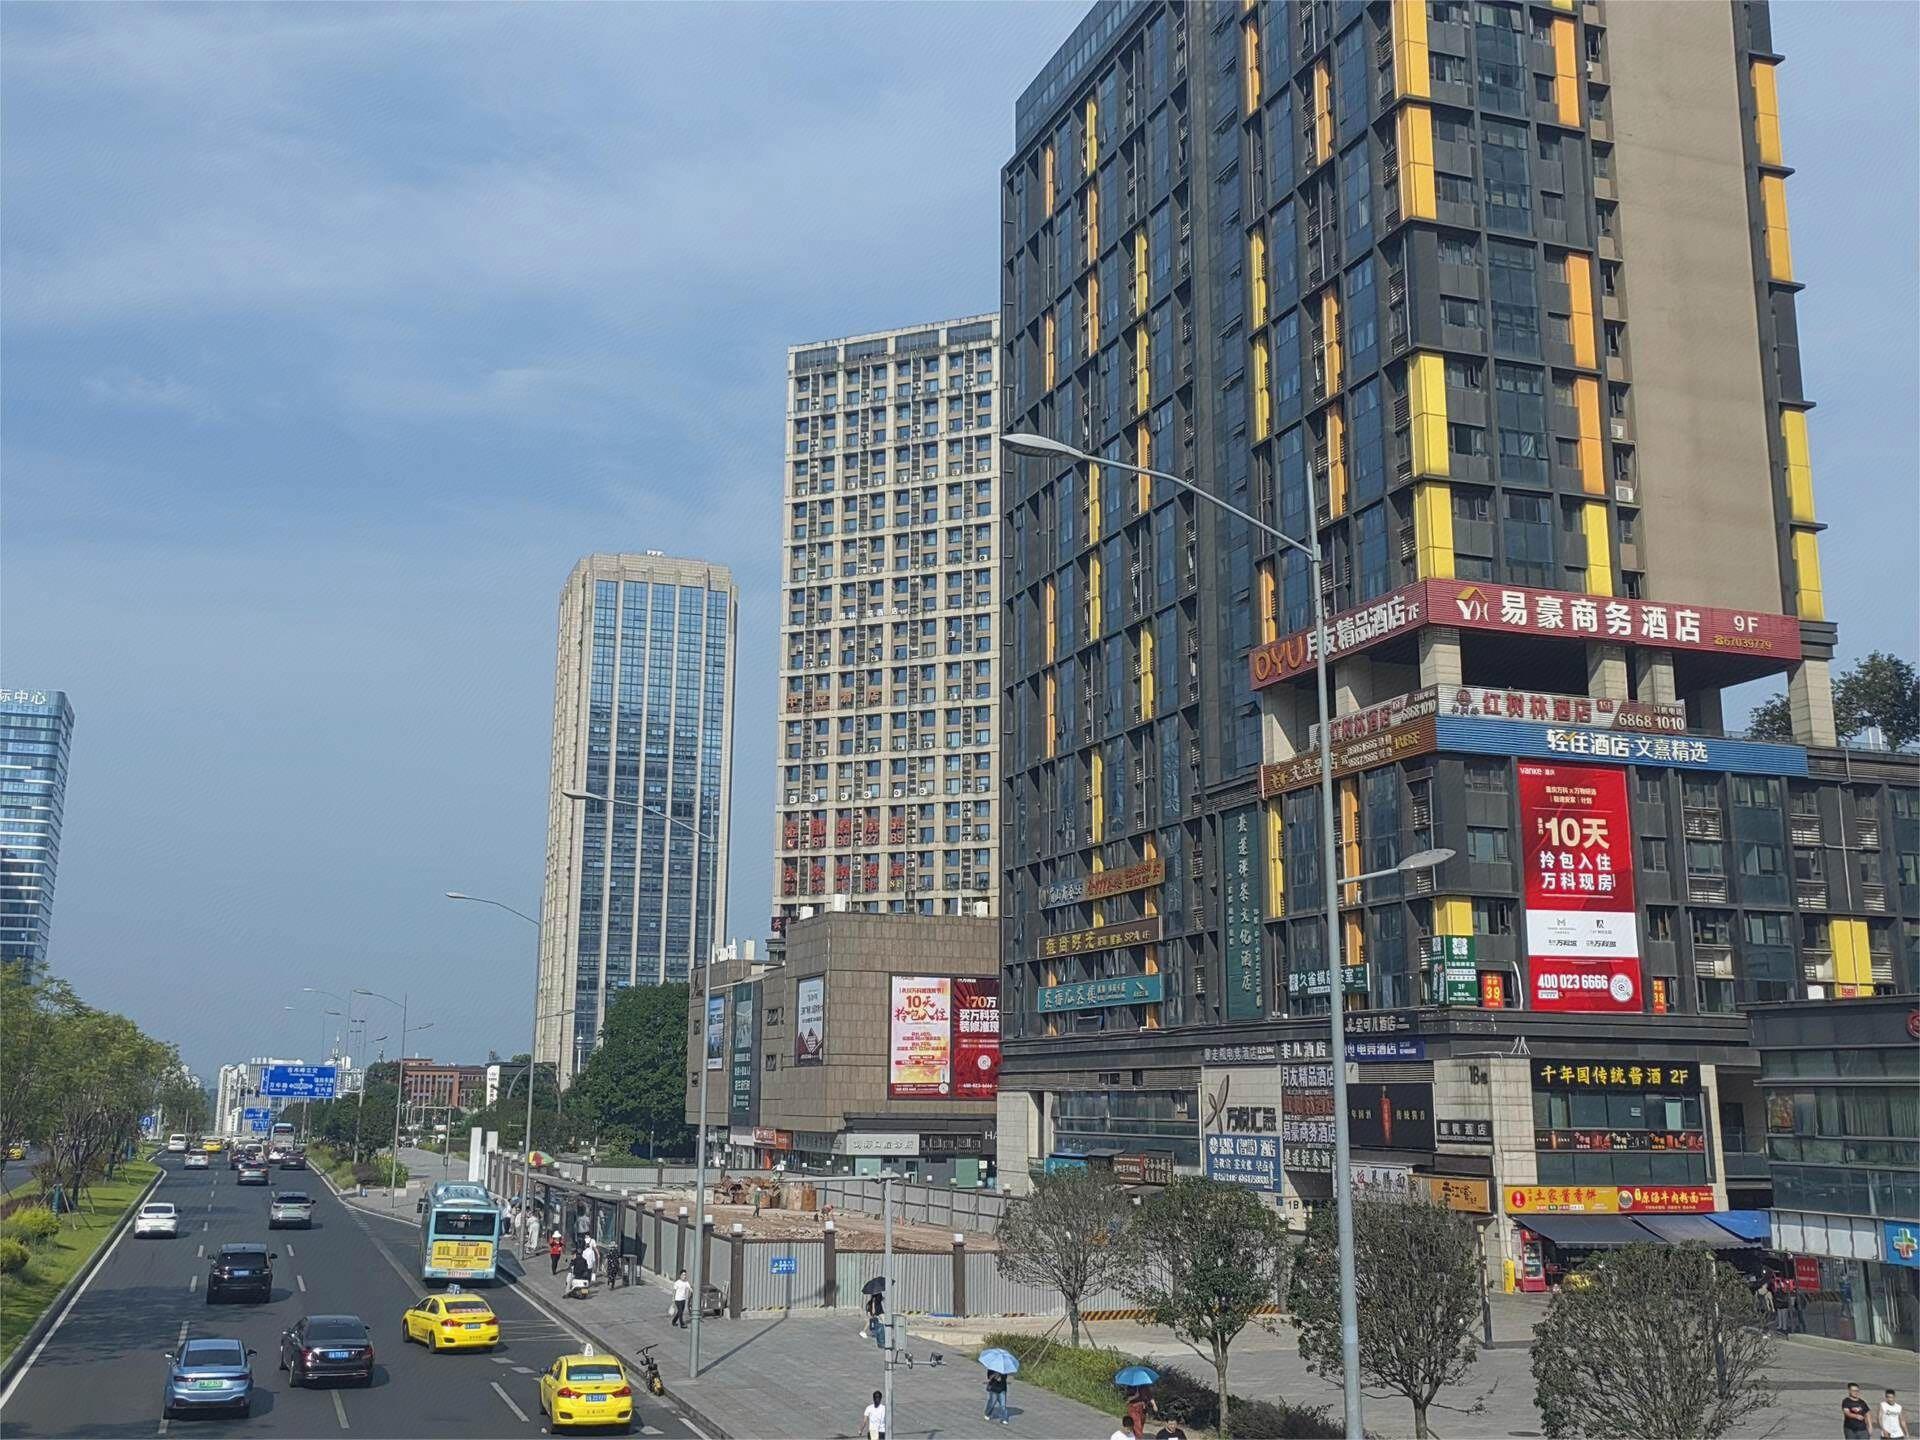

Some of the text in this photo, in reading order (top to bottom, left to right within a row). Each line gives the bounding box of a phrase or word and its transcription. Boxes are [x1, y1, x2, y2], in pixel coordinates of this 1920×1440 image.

[1500, 589, 1759, 644] 易豪商务酒店 9F
[1482, 692, 1592, 724] 红树林酒店
[1618, 711, 1685, 732] 6868 1010
[1545, 817, 1610, 849] 10天
[1540, 850, 1612, 872] 拎包入住
[1541, 872, 1612, 892] 万科现房
[1537, 974, 1609, 989] 400 023 6666
[1281, 1065, 1334, 1088] 月友精品酒店
[1541, 1065, 1689, 1086] 千年国传统酱酒 2F
[1282, 1122, 1337, 1145] 易豪商务酒店
